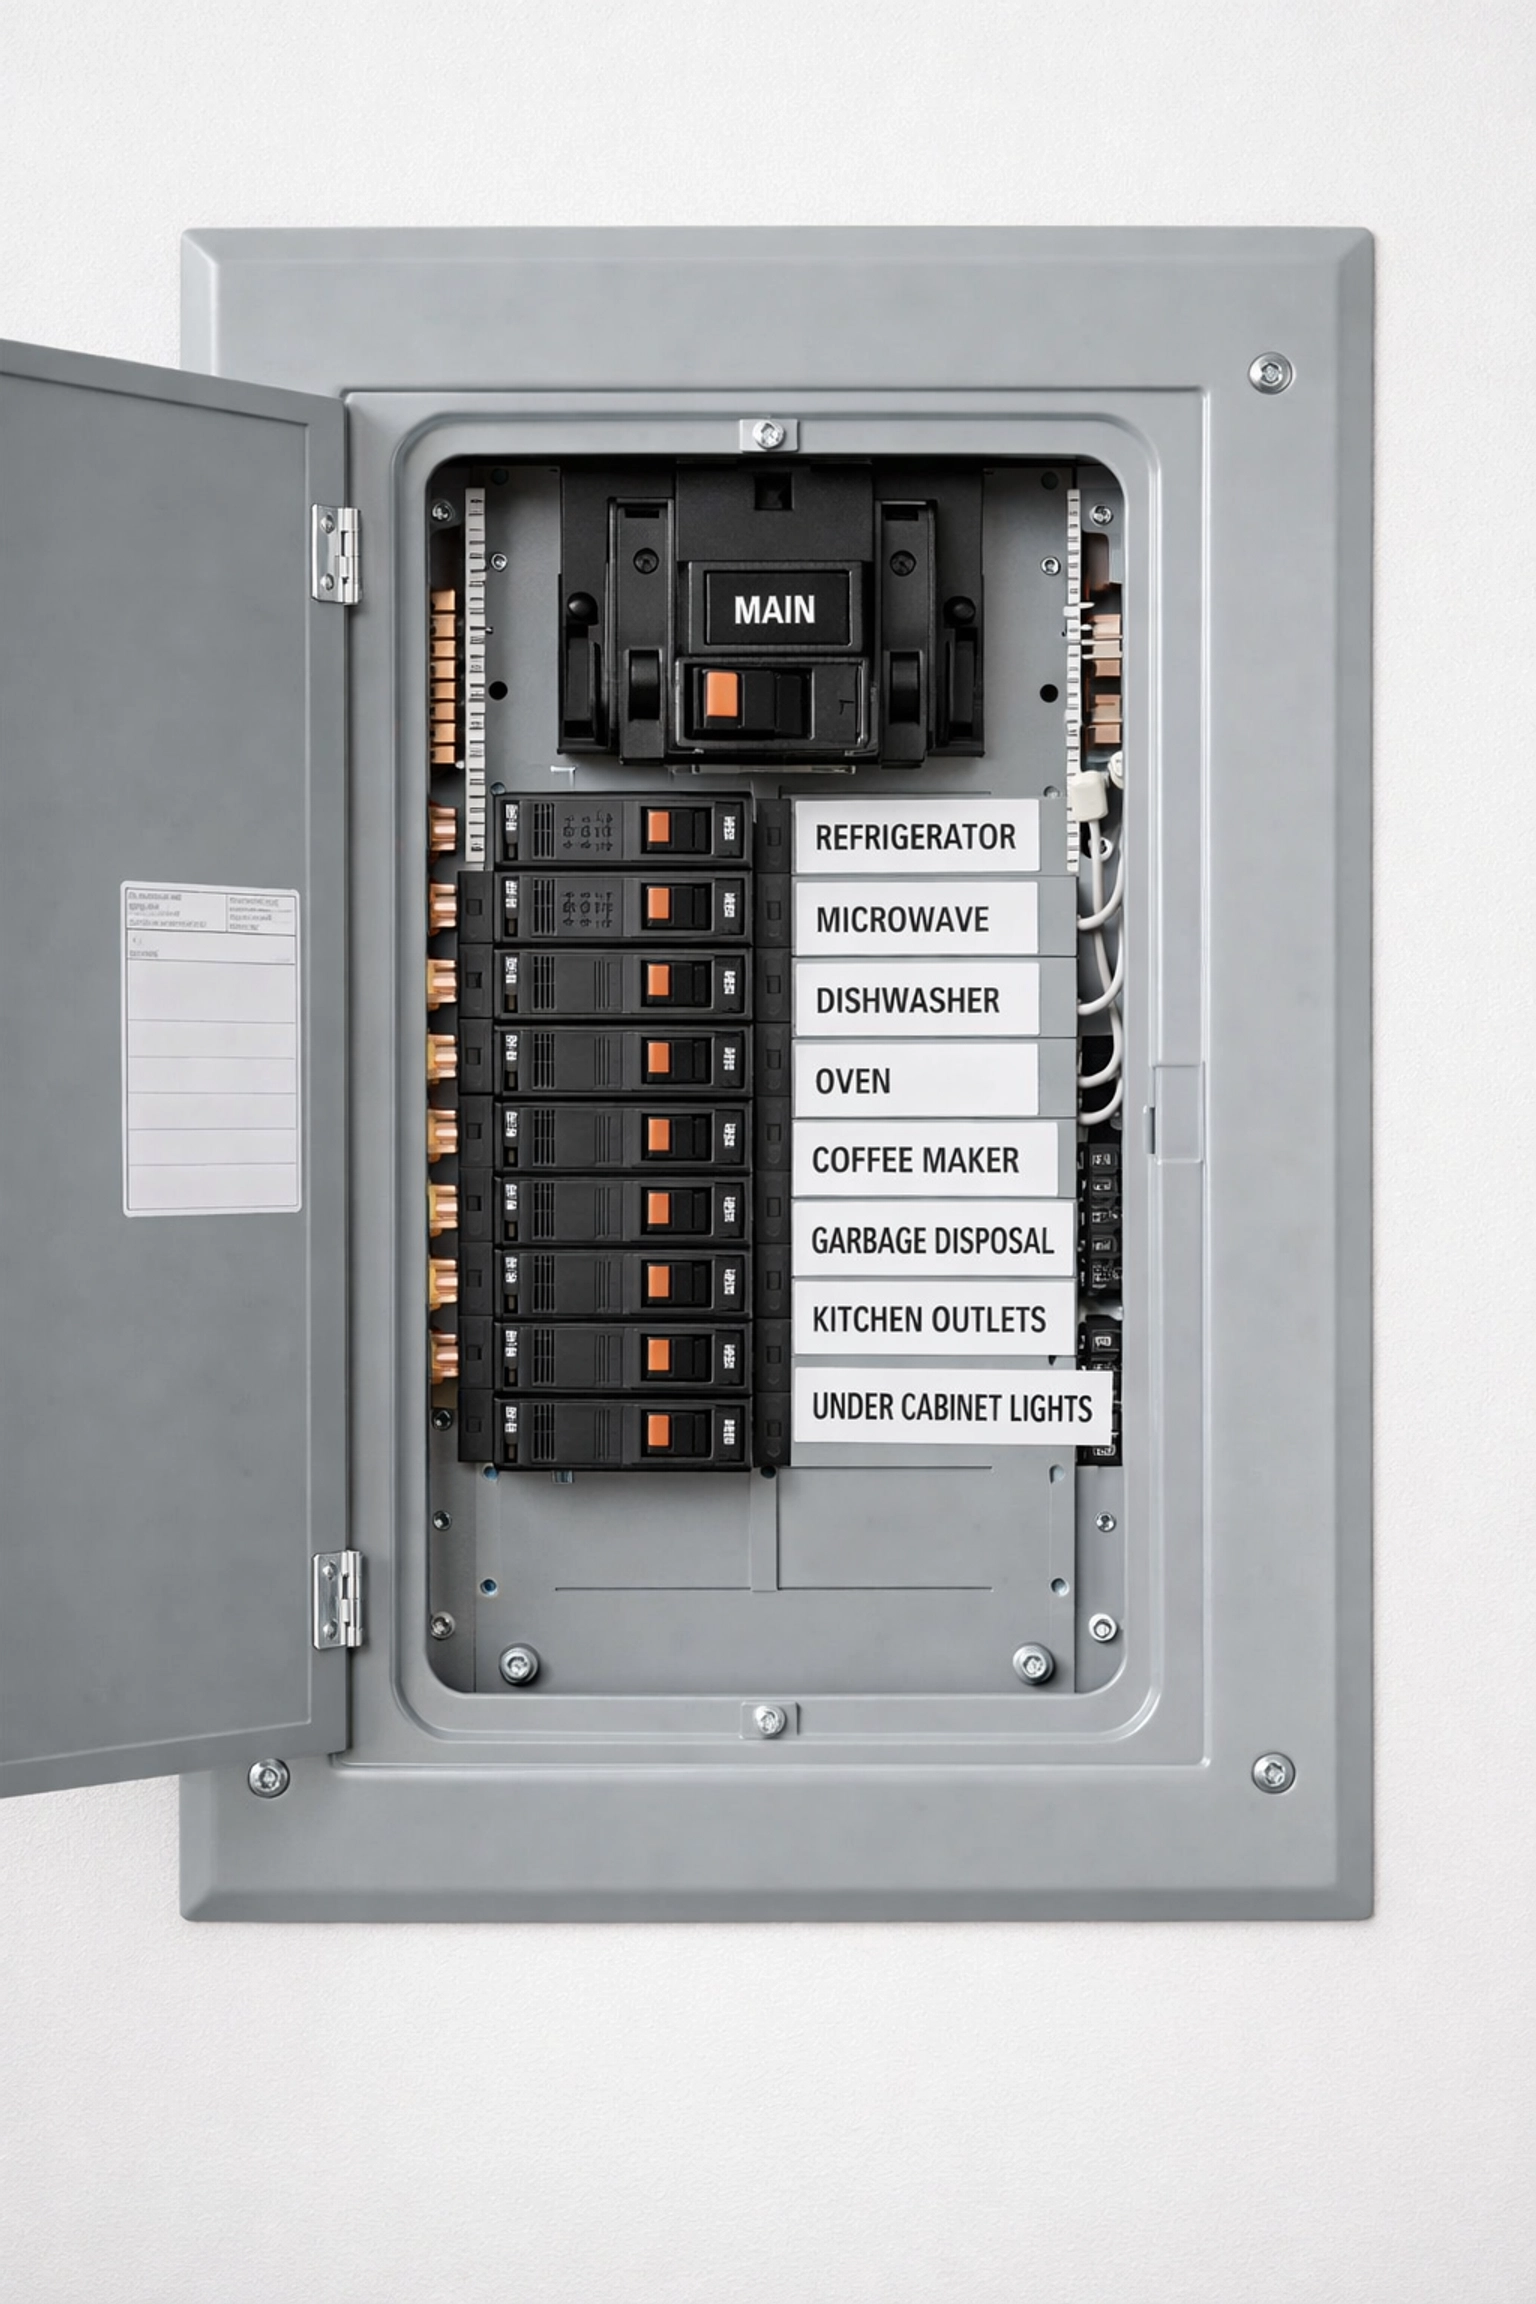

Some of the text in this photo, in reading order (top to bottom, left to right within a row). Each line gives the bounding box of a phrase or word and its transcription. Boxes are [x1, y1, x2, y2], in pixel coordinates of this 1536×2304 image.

[735, 595, 815, 624] MAIN
[817, 824, 1015, 850] REFRIGERATOR
[818, 906, 988, 932] MICROWAVE
[818, 987, 999, 1013] DISHWASHER
[816, 1068, 890, 1094] OVEN
[813, 1147, 1019, 1173] COFFEE MAKER
[812, 1227, 1054, 1254] GARBAGE DISPOSAL
[814, 1306, 1046, 1333] KITCHEN OUTLETS
[814, 1392, 1092, 1422] UNDER CABINET LIGHTS
